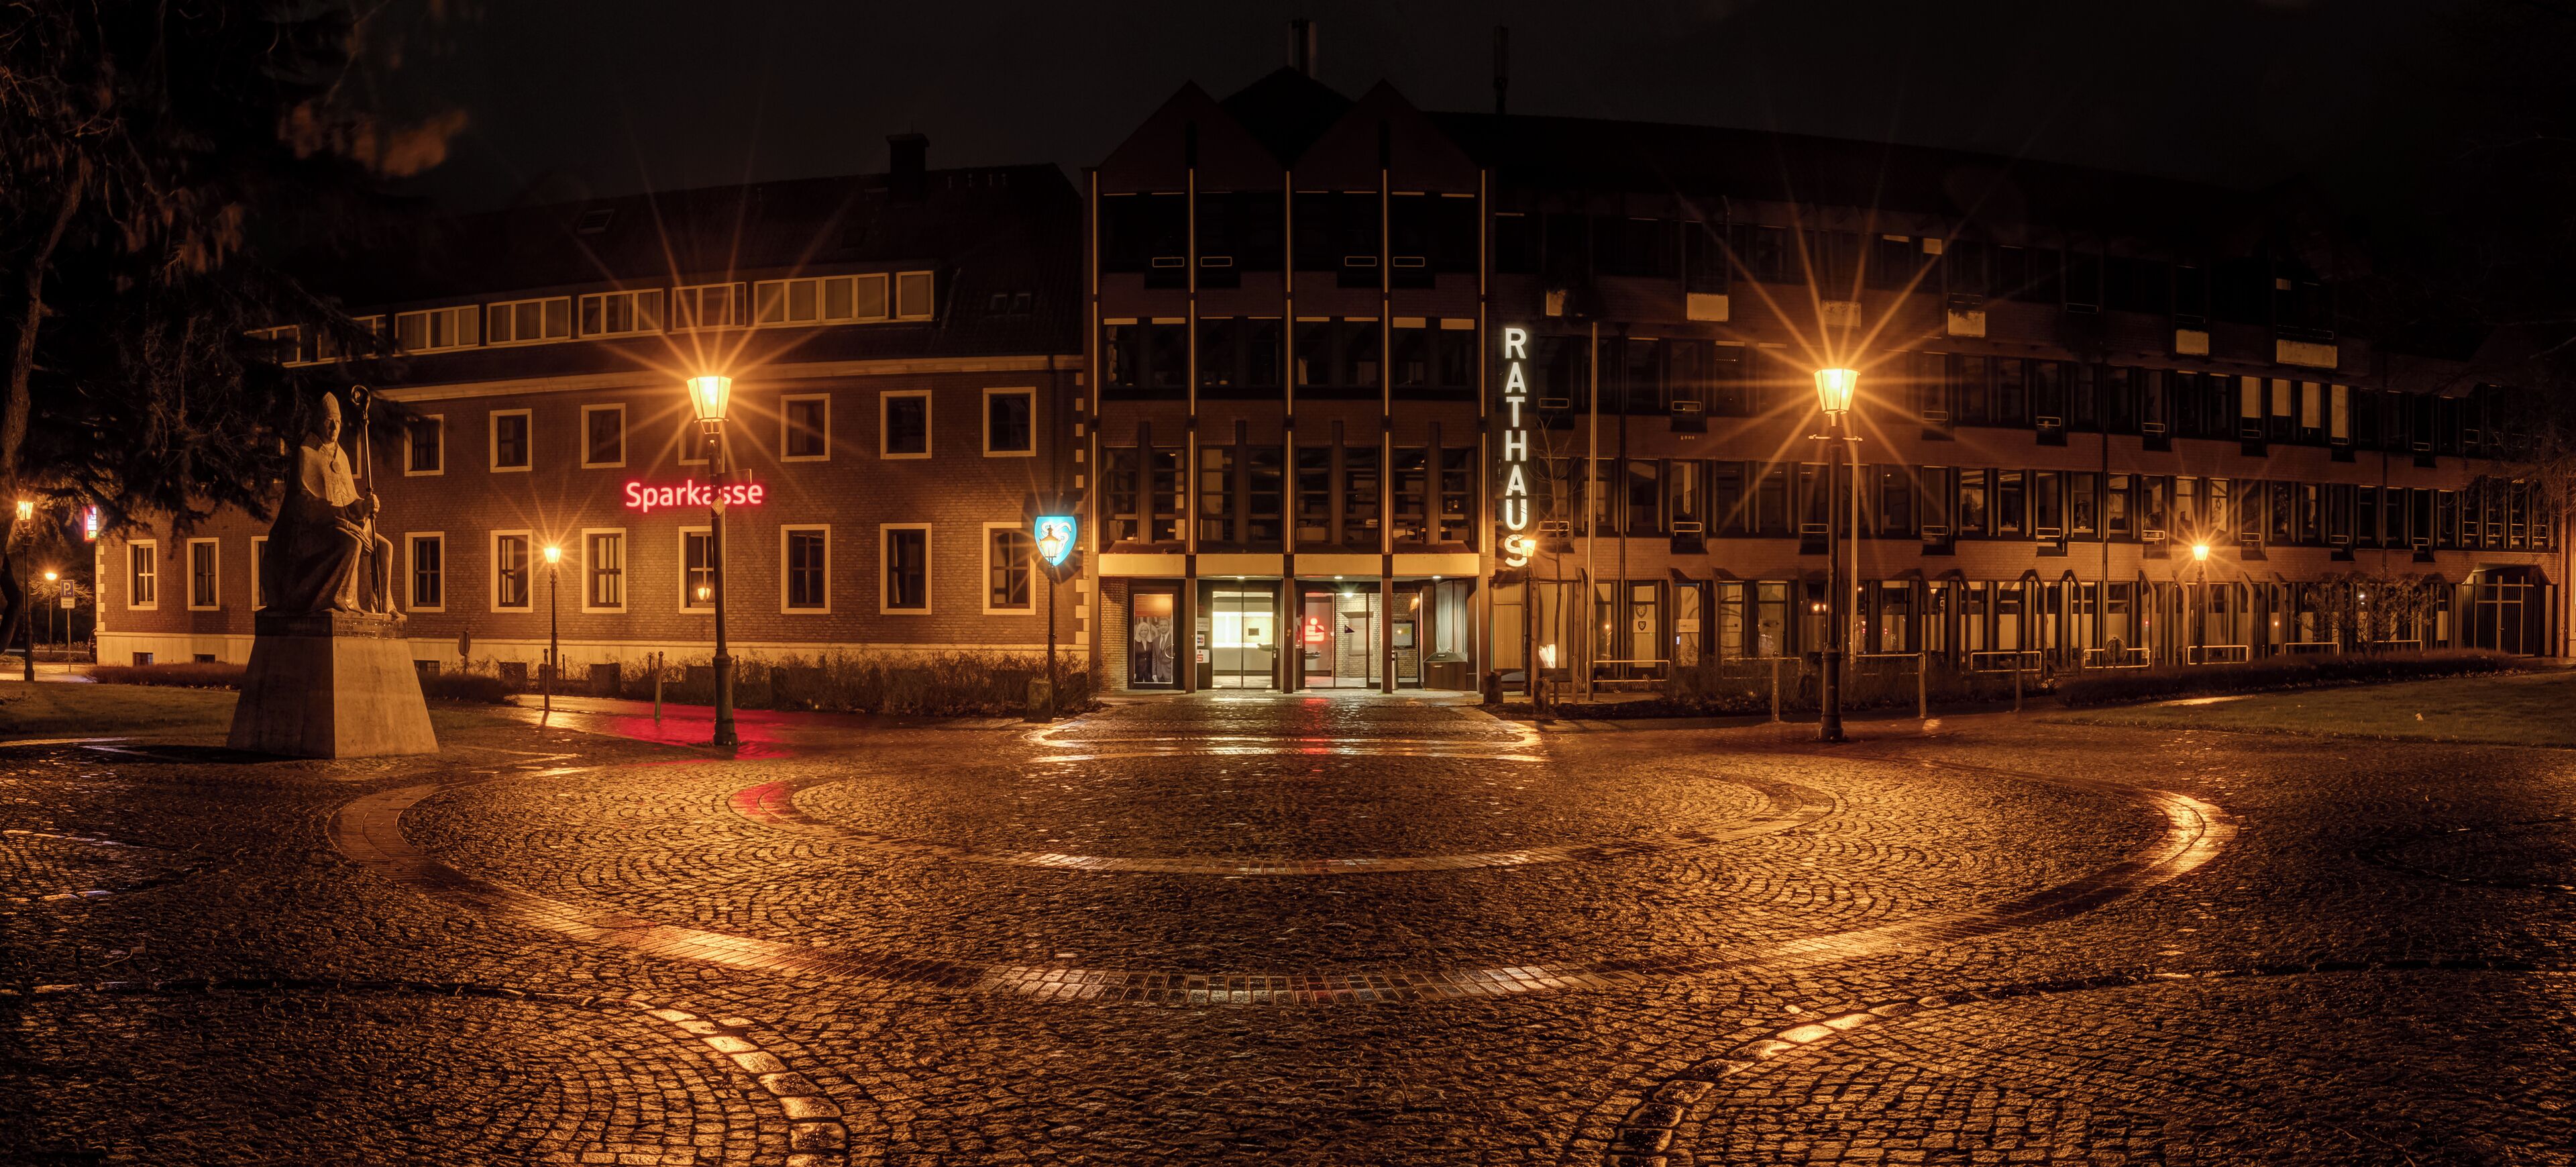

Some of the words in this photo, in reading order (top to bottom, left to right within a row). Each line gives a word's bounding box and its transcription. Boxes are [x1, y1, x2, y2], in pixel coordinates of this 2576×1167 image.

[1504, 327, 1528, 567] RATHAUS
[625, 479, 763, 512] Sparkasse
[64, 582, 71, 596] P
